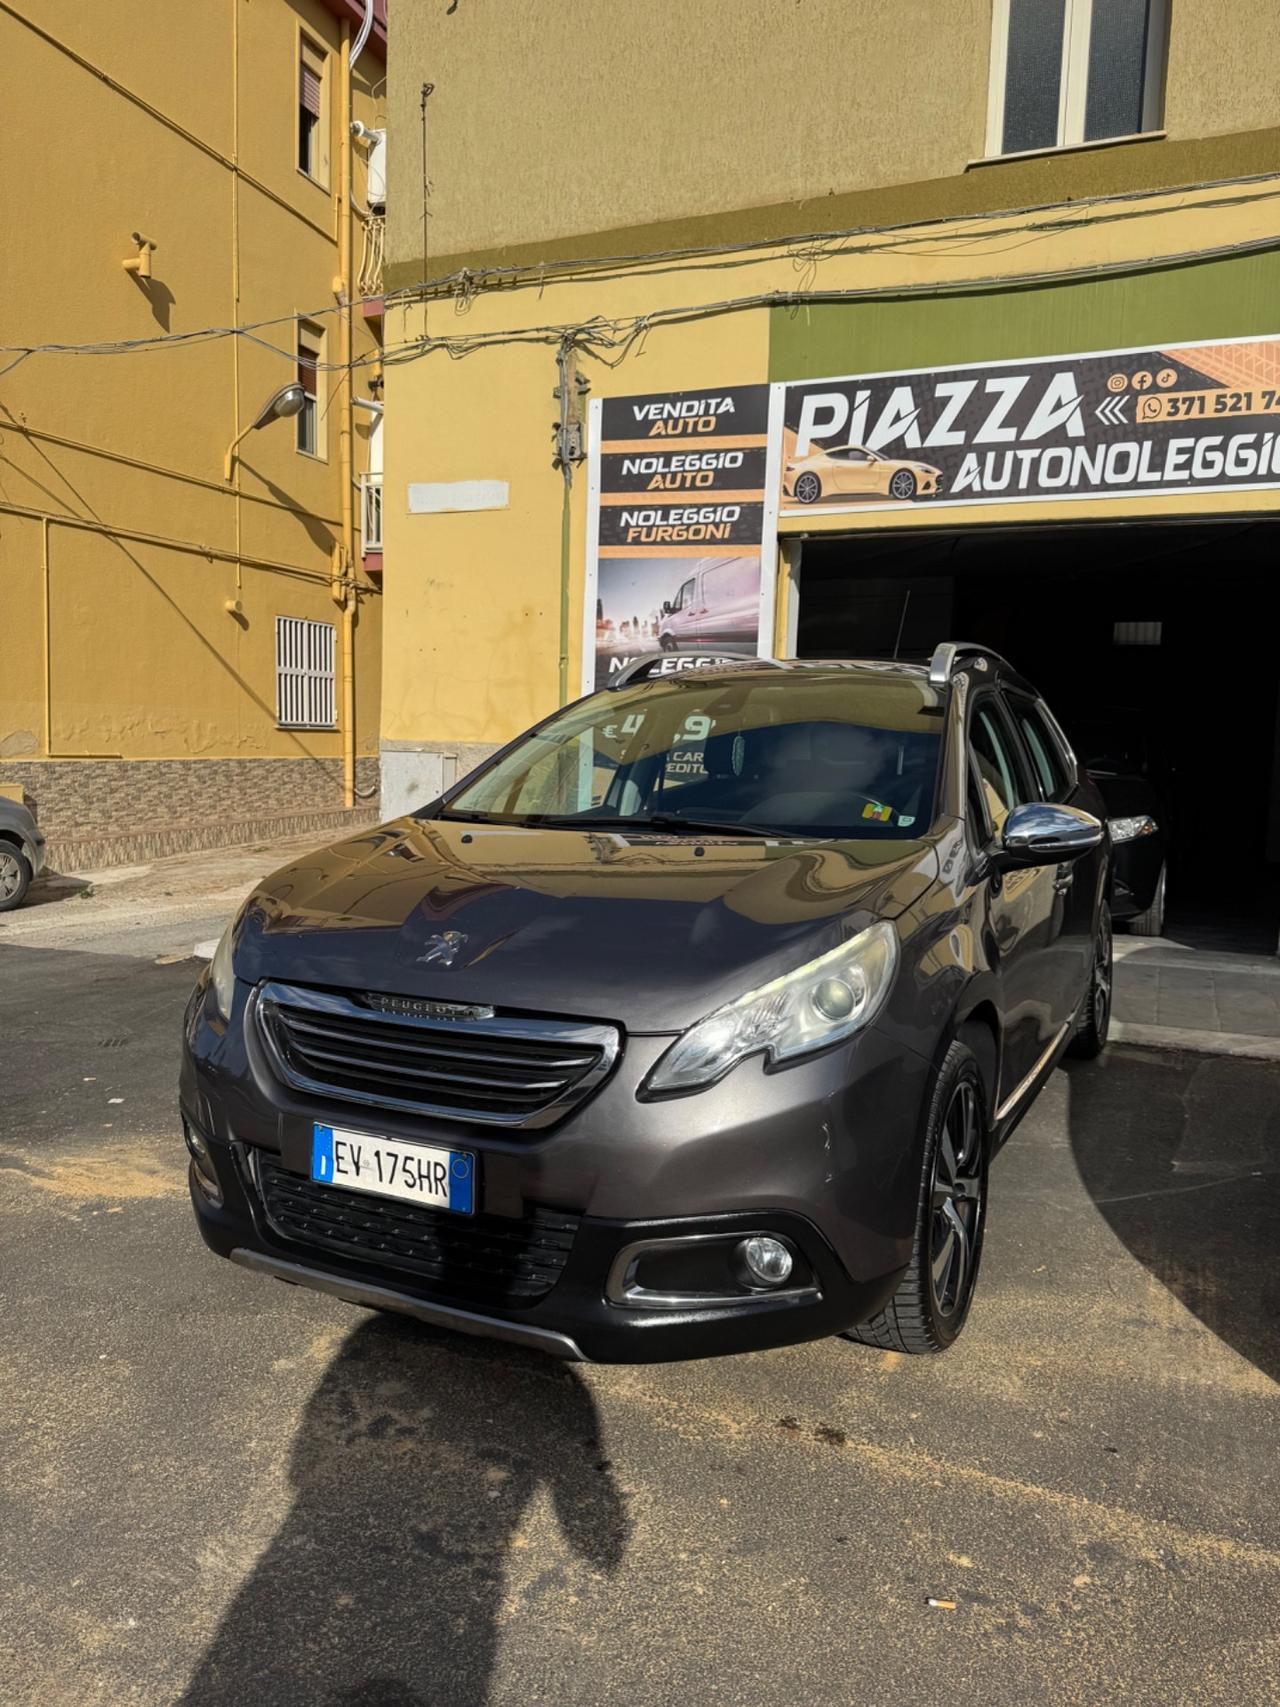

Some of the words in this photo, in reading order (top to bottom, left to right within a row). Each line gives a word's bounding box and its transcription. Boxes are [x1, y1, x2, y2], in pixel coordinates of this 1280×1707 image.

[633, 397, 736, 421] VENDITA
[795, 371, 1085, 457] PIAZZA
[1167, 395, 1205, 416] 371
[1213, 392, 1252, 413] 521
[648, 415, 716, 437] AUTO
[622, 451, 744, 475] NOLEGGIO
[950, 432, 1280, 493] AUTONOLEGGI
[647, 470, 715, 490] AUTO
[620, 506, 740, 527] NOLEGGIO
[626, 523, 731, 543] FURGONI
[335, 1141, 361, 1176] EV
[374, 1150, 448, 1198] 175HR
